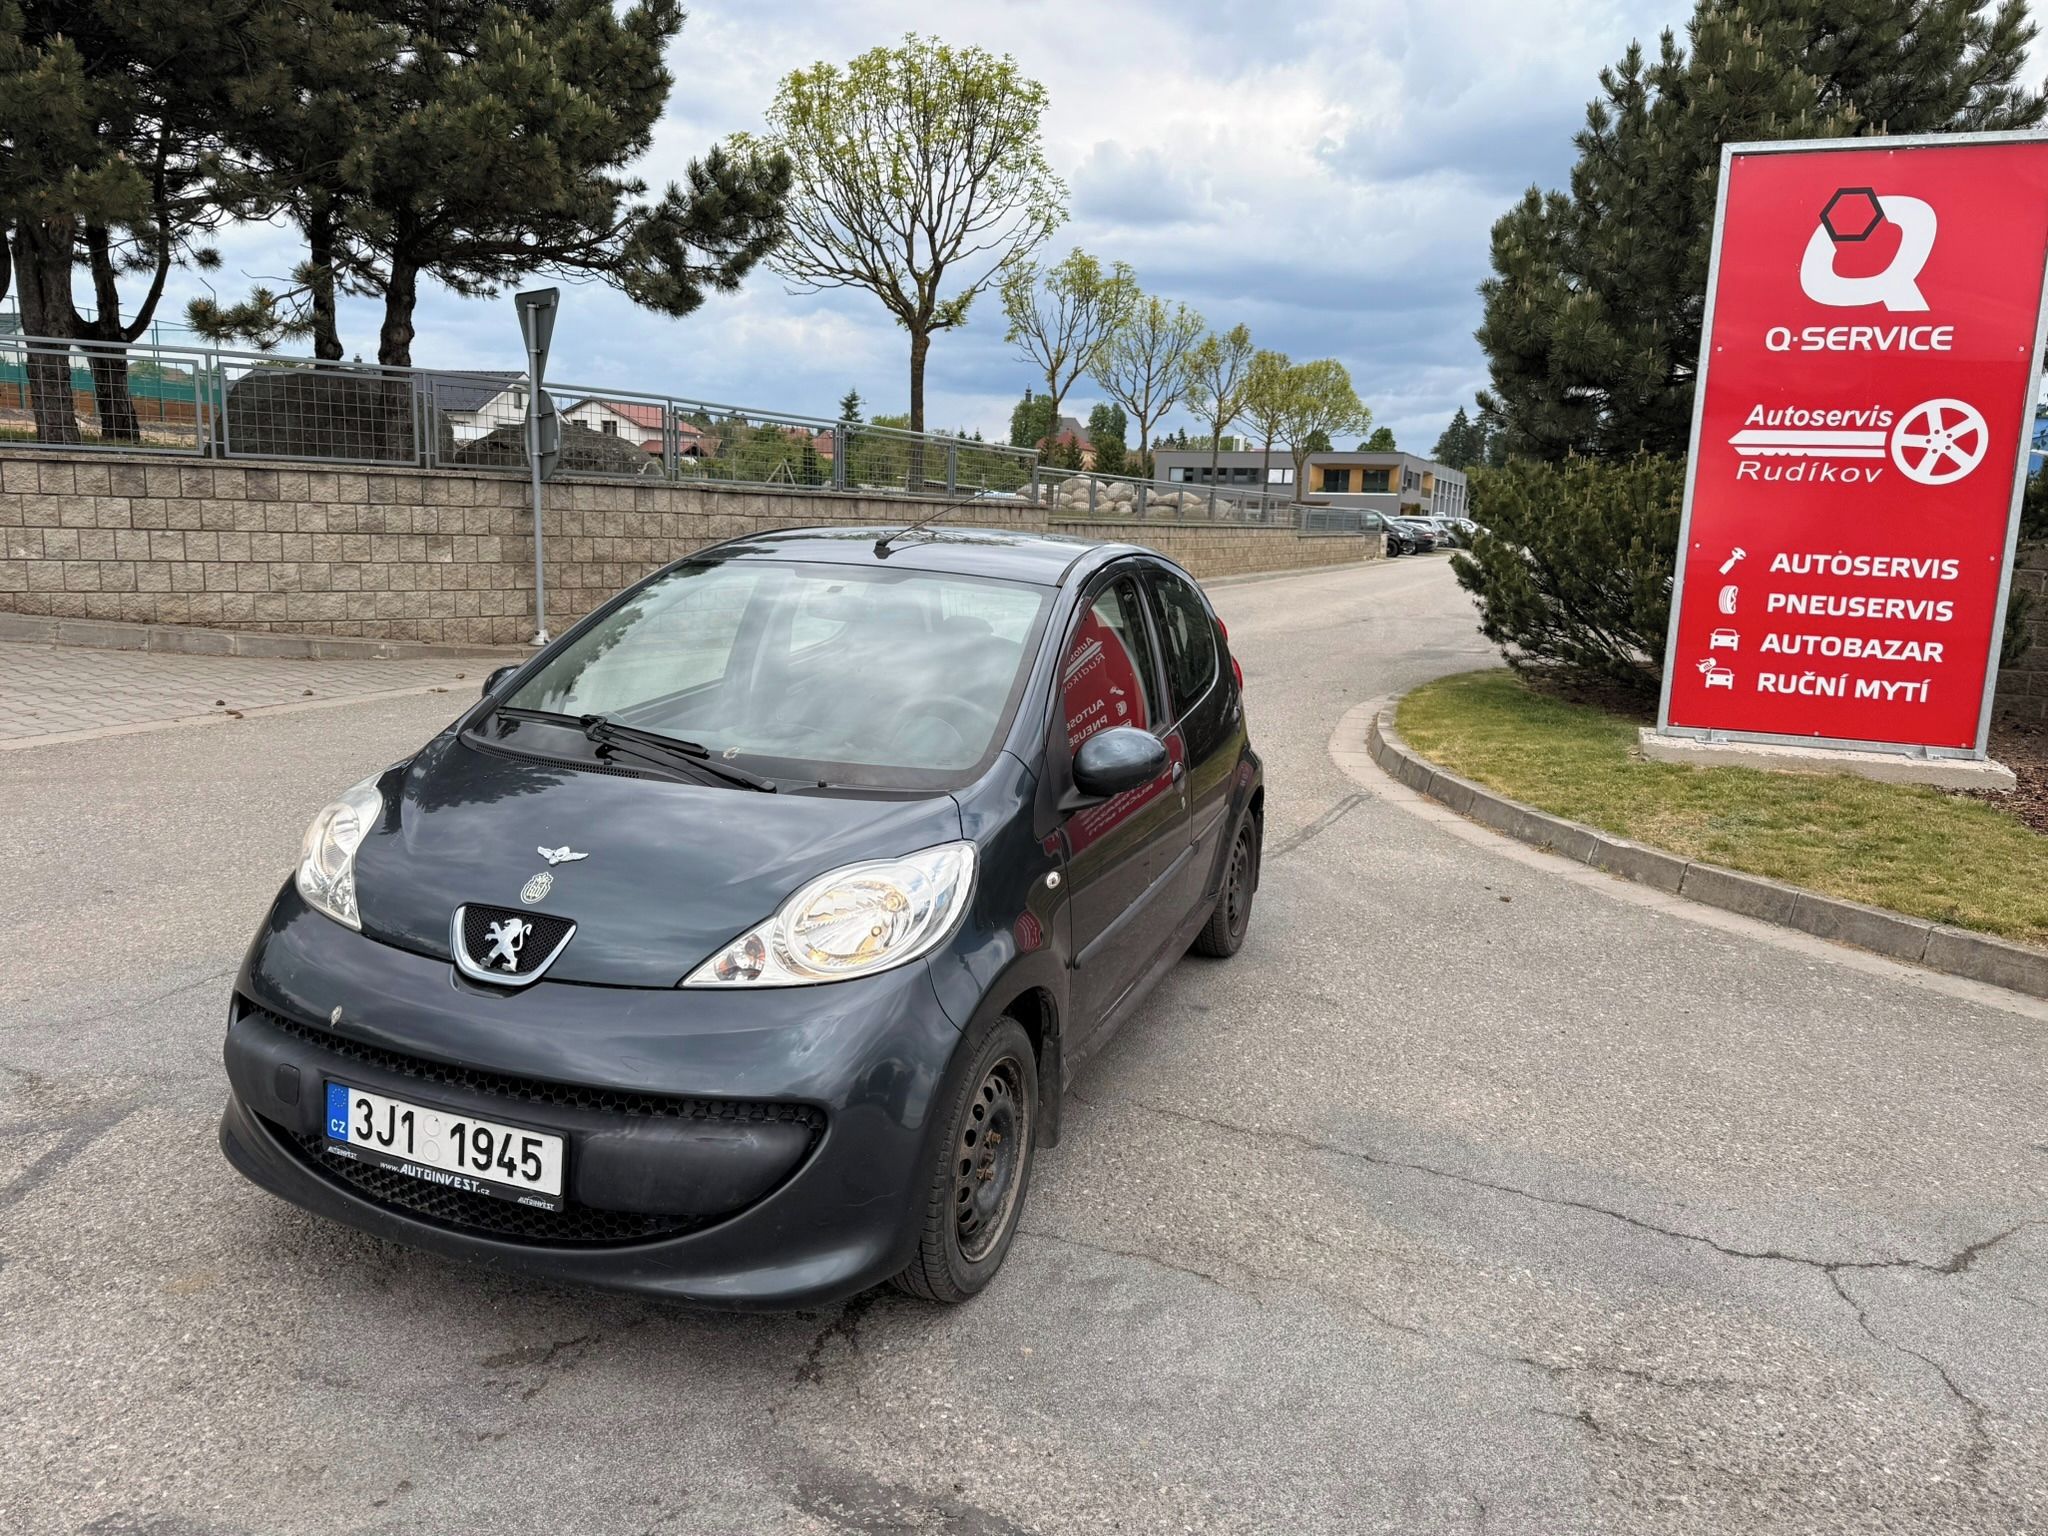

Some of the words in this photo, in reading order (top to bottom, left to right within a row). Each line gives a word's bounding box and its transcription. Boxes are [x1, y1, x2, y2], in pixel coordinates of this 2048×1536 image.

[1745, 403, 1893, 428] Autoservis
[1736, 460, 1883, 483] Rudíkov
[1769, 552, 1960, 580] AUTOSERVIS
[1766, 592, 1954, 622] PNEUSERVIS
[1759, 632, 1944, 663] AUTOBAZAR
[1757, 670, 1850, 697] RUČNÍ
[1854, 678, 1932, 703] MYTÍ
[331, 1118, 346, 1134] CZ
[355, 1098, 414, 1154] 3J1
[449, 1122, 543, 1182] 1945
[379, 1162, 490, 1196] www.AUTOINVEST.cz
